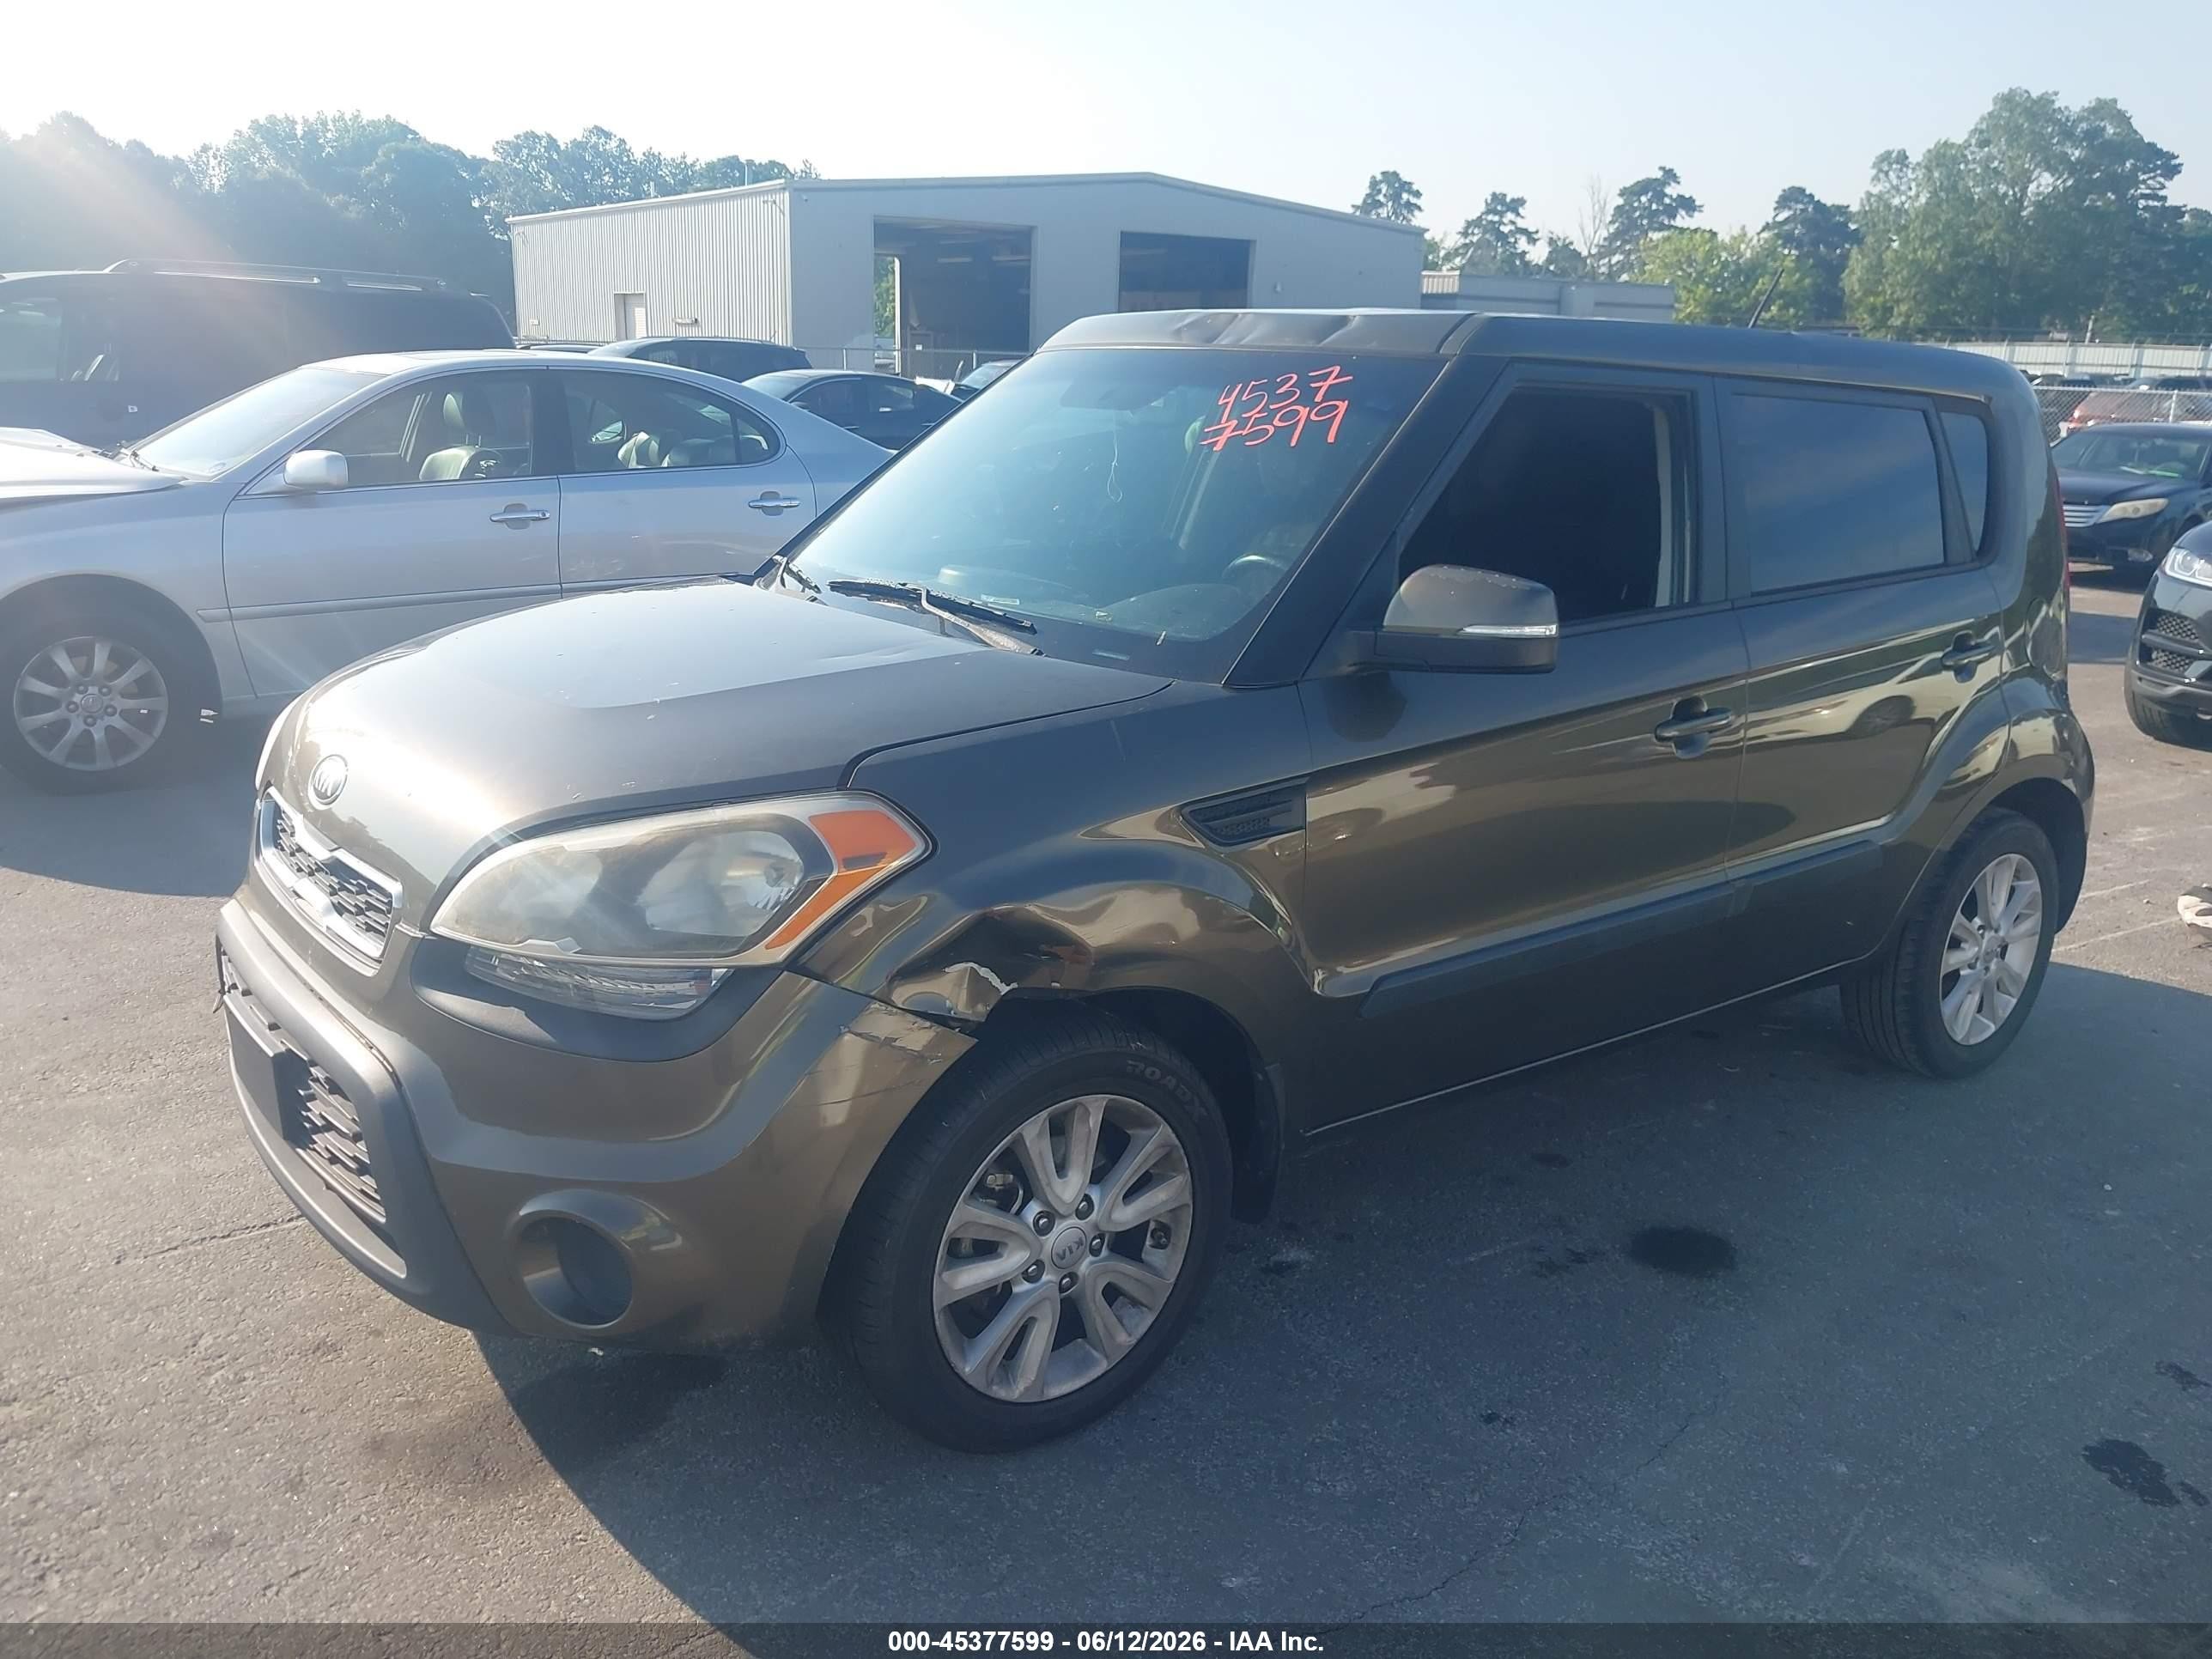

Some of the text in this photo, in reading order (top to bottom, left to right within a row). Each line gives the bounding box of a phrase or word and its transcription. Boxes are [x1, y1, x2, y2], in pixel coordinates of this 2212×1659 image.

[1218, 365, 1354, 424] 4537
[1199, 399, 1349, 452] 7599
[1126, 1058, 1209, 1122] ROADX
[1056, 1236, 1085, 1261] KIA
